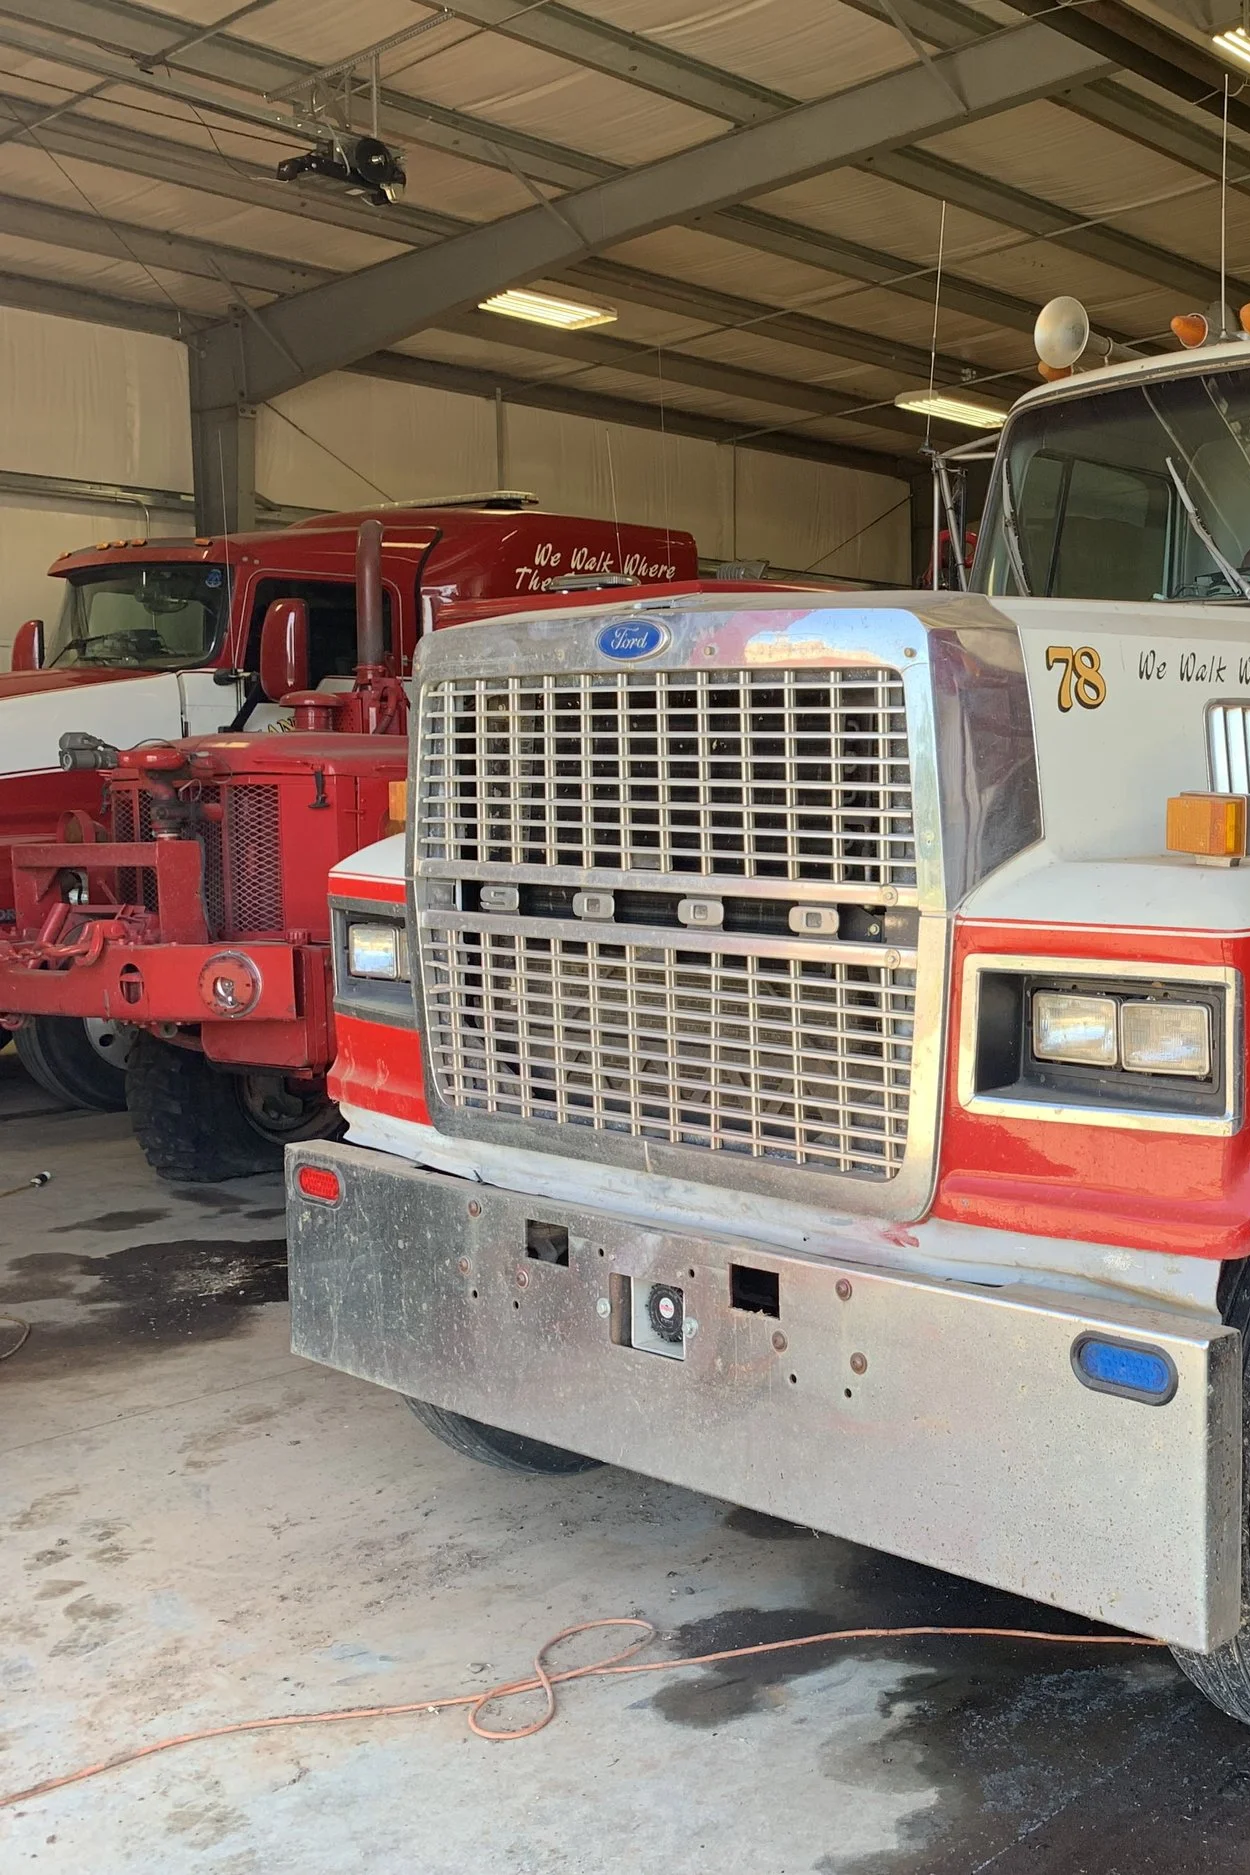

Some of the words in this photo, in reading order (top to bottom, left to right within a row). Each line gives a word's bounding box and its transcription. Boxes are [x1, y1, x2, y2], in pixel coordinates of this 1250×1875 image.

[534, 543, 561, 567] We
[571, 547, 614, 573] Walk
[623, 553, 677, 579] Where
[515, 566, 553, 591] The
[611, 627, 649, 650] Ford
[1046, 645, 1106, 712] 78
[1139, 650, 1167, 681] We
[1180, 653, 1227, 684] Walk
